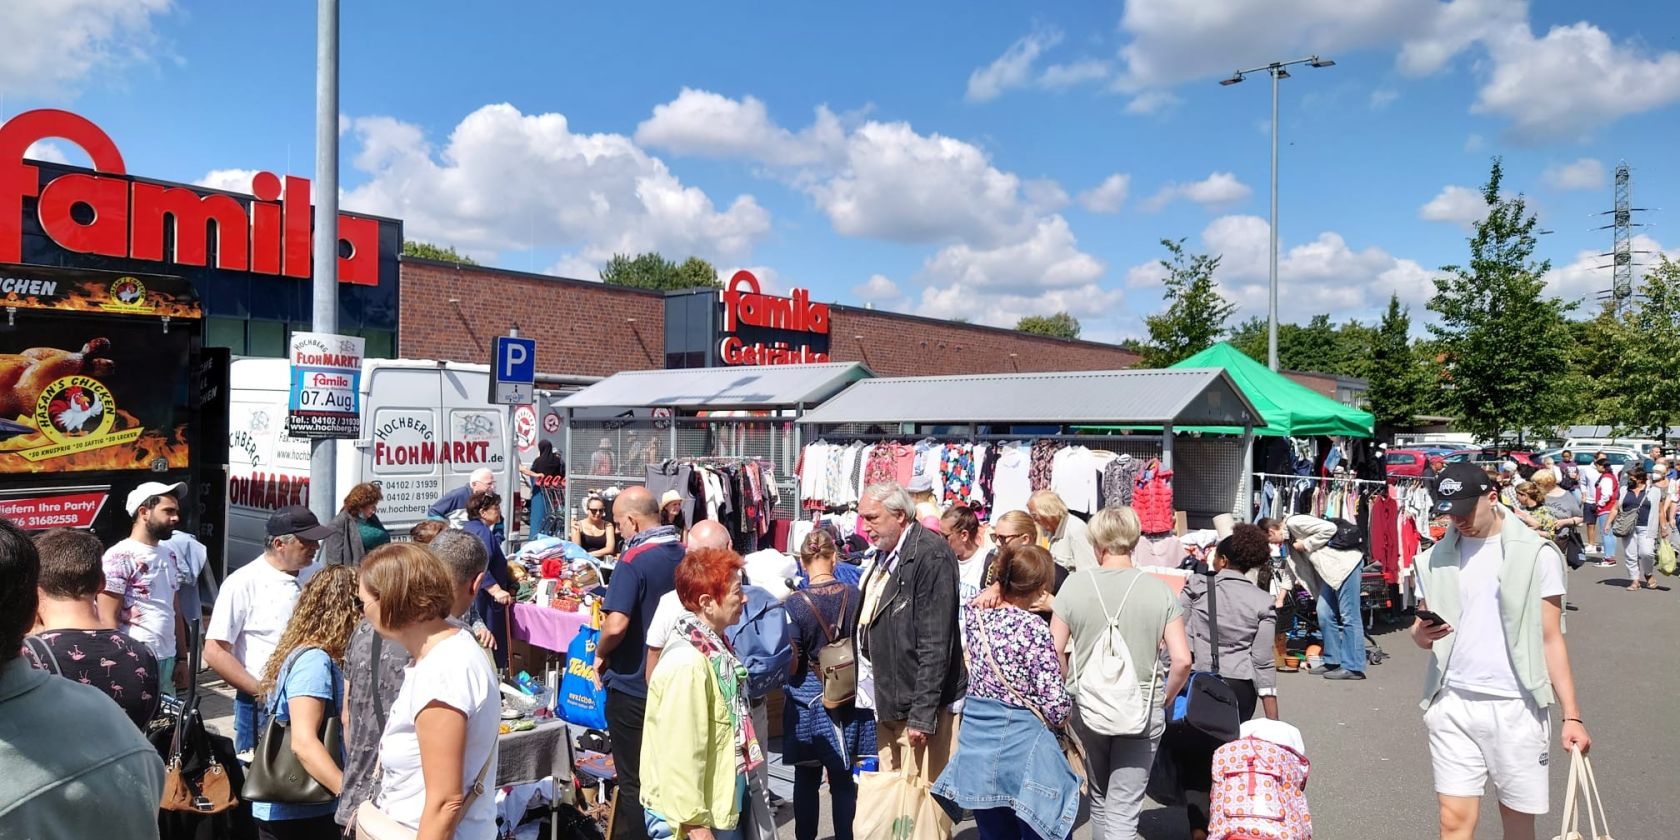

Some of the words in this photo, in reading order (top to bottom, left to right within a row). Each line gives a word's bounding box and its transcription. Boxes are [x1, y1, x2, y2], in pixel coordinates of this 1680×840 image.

[0, 108, 379, 286] famila
[0, 278, 57, 296] CHEN
[720, 269, 830, 334] famila
[294, 339, 328, 353] HOCHBERG
[506, 343, 527, 376] P
[313, 372, 348, 386] famila
[38, 379, 65, 428] HASAN'S
[71, 377, 115, 415] CHICKEN
[301, 390, 355, 411] 07.Aug.
[291, 416, 309, 424] Tel.:
[311, 416, 336, 424] 04102
[290, 424, 360, 433] www.hochberg.tv
[375, 417, 433, 440] HOCHBERG
[229, 430, 260, 467] CHBERG
[277, 450, 311, 461] www.hochb
[229, 471, 310, 510] OHMARKT
[386, 480, 409, 489] 04102
[416, 480, 438, 489] 31939
[386, 492, 410, 501] 04102
[416, 491, 439, 500] 81990
[38, 503, 61, 512] Ihre
[64, 500, 96, 512] Party!
[28, 514, 78, 526] 31682558
